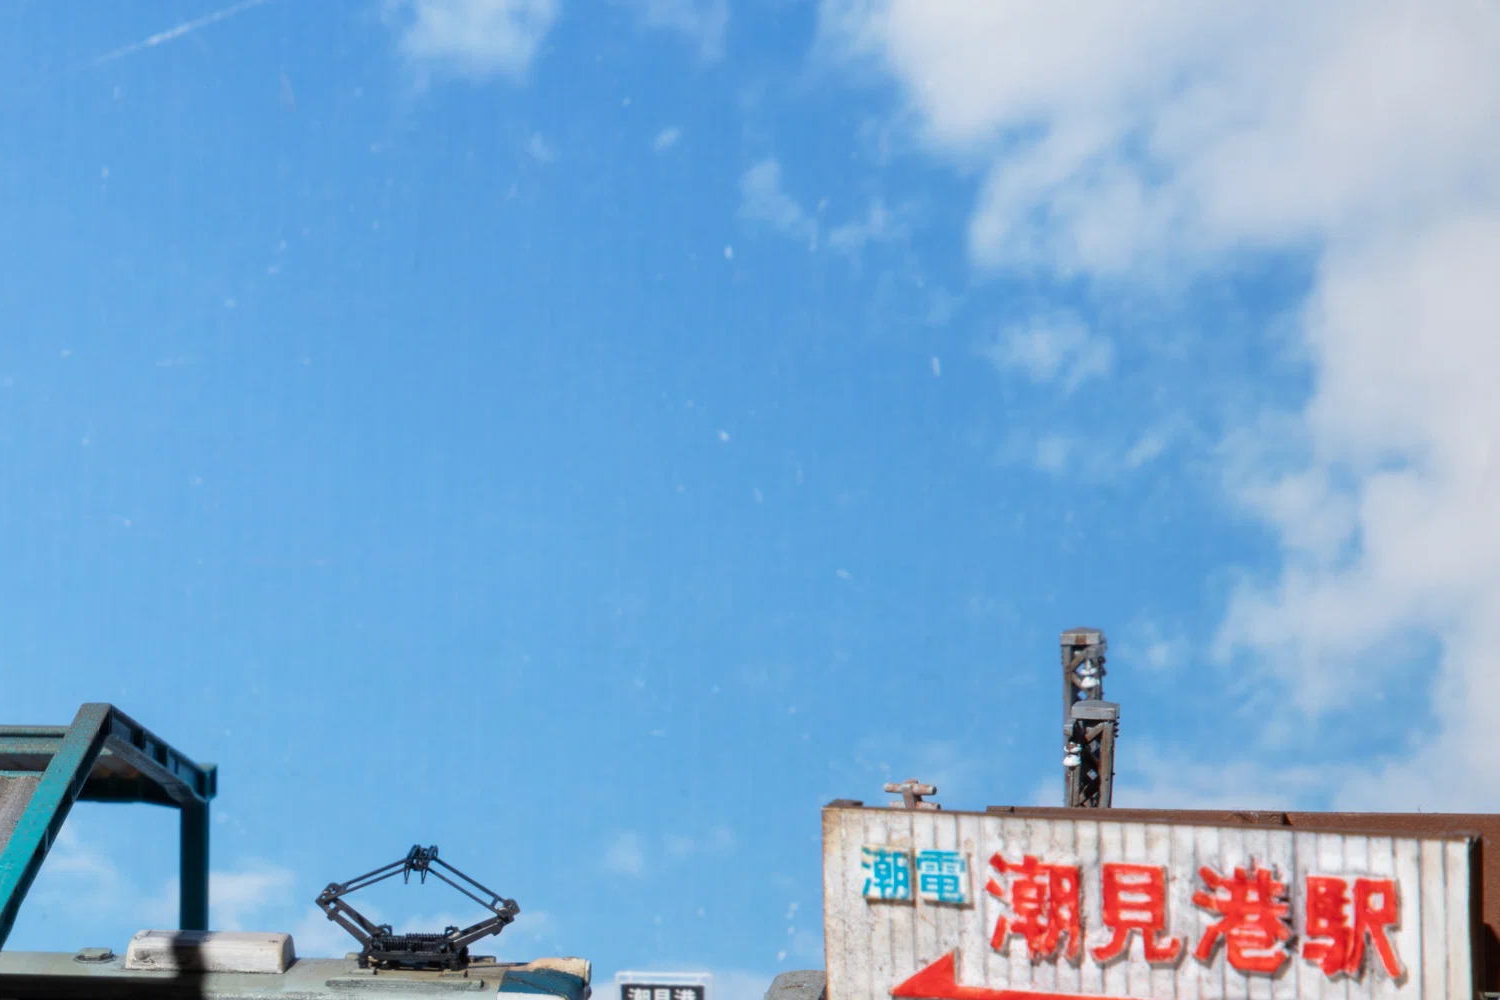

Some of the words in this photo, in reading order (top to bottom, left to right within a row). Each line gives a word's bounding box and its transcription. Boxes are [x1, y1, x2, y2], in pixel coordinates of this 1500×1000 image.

[861, 846, 966, 903] 潮電
[985, 852, 1403, 981] 潮見港駅
